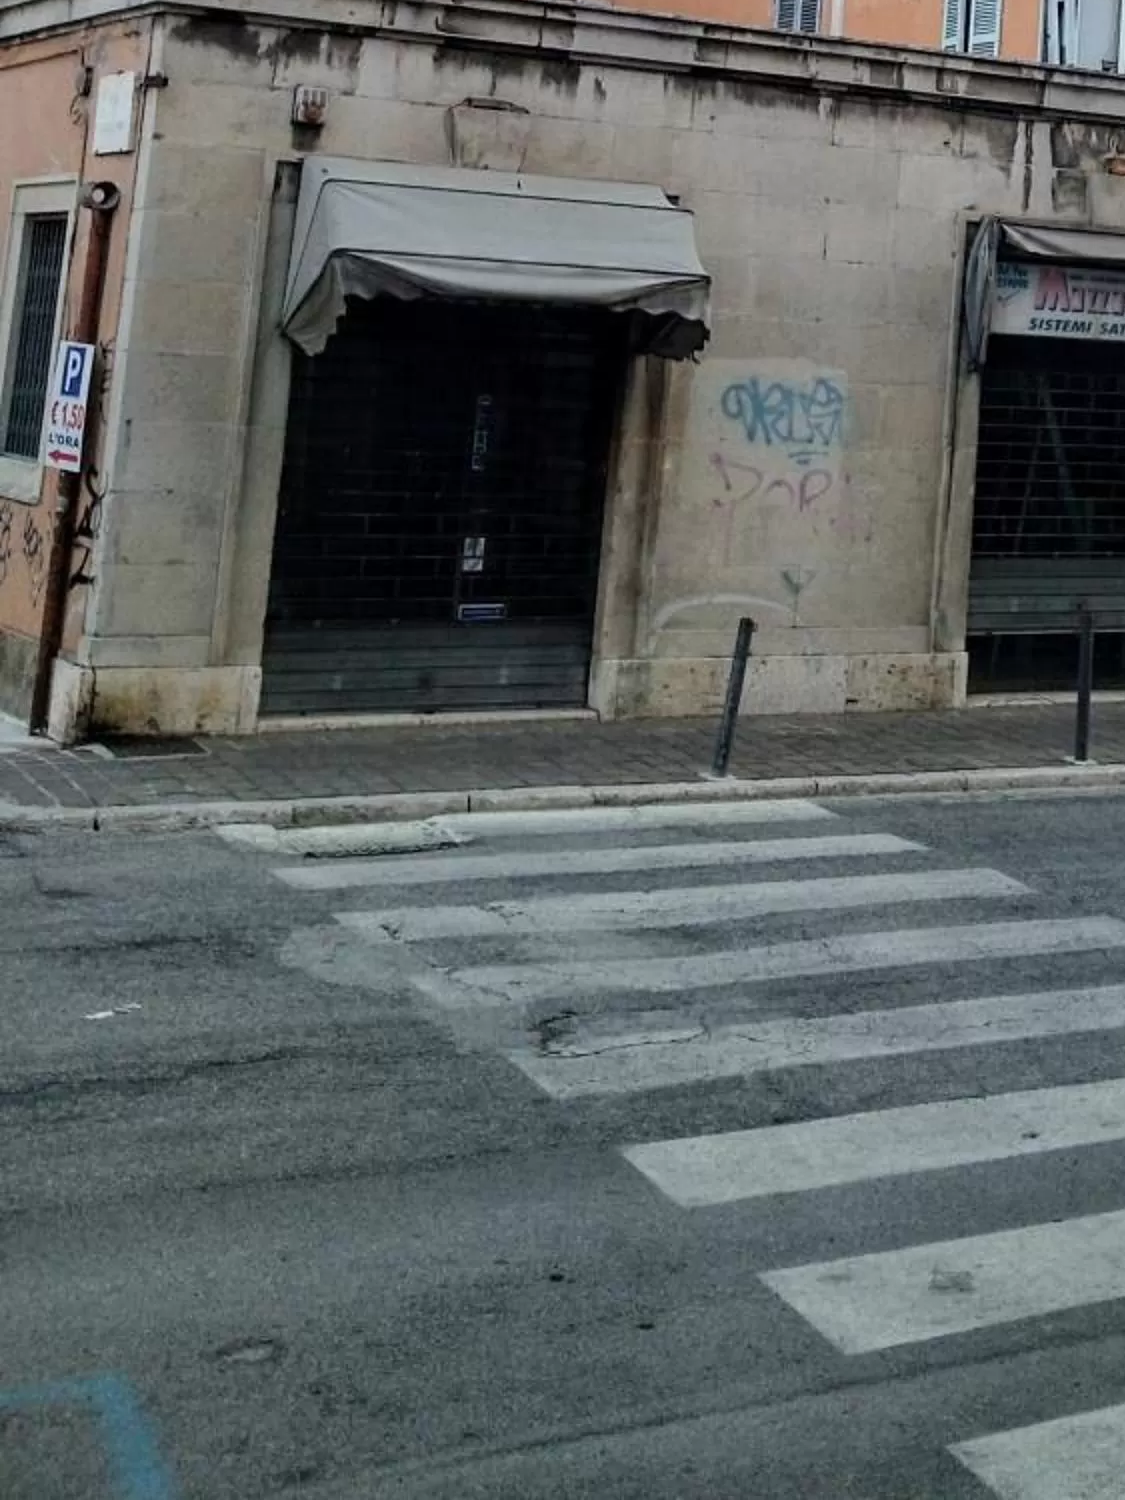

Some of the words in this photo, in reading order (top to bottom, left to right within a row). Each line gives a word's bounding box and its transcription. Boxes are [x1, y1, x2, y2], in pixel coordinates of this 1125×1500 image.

[1028, 317, 1093, 335] SISTEMI
[64, 350, 82, 393] P
[48, 432, 79, 449] L'ORA
